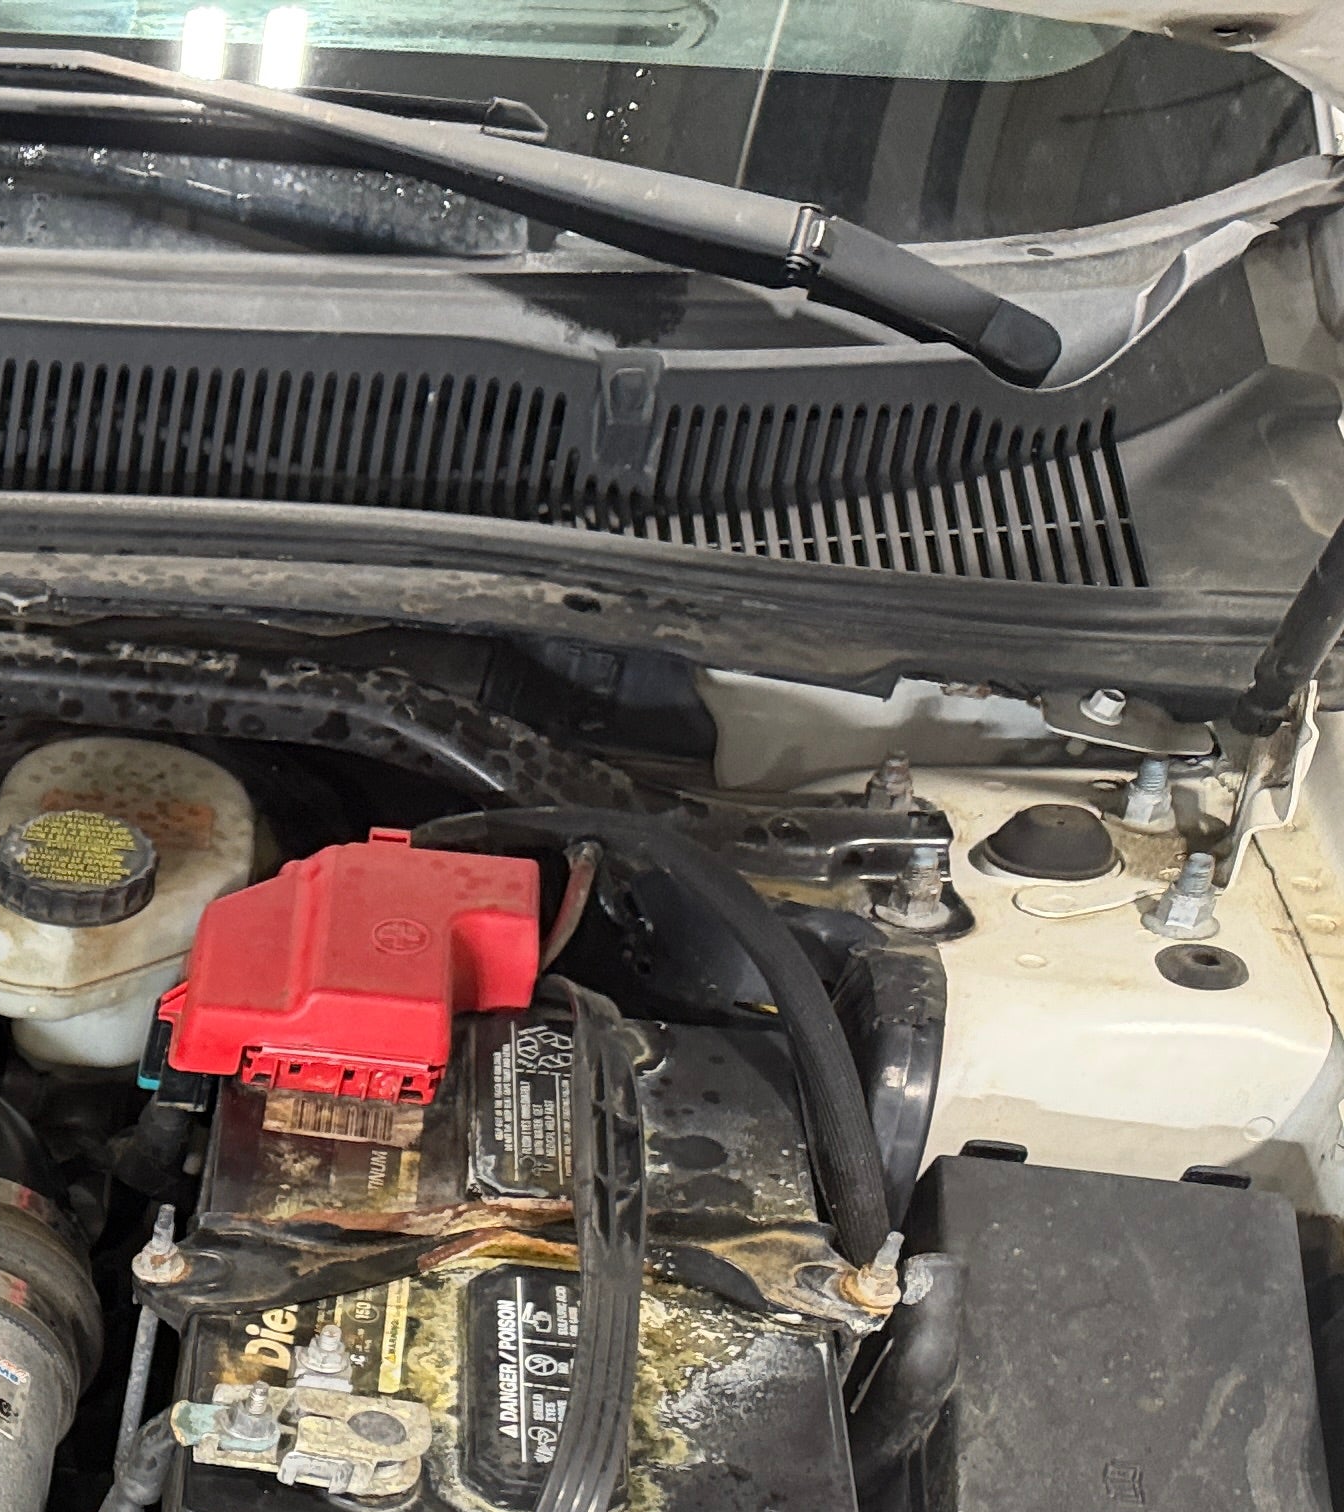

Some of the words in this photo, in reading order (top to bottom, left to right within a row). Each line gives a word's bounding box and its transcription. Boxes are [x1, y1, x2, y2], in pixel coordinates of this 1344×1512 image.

[241, 1304, 299, 1370] Die
[497, 1299, 517, 1350] POISON
[499, 1363, 518, 1422] DANGER
